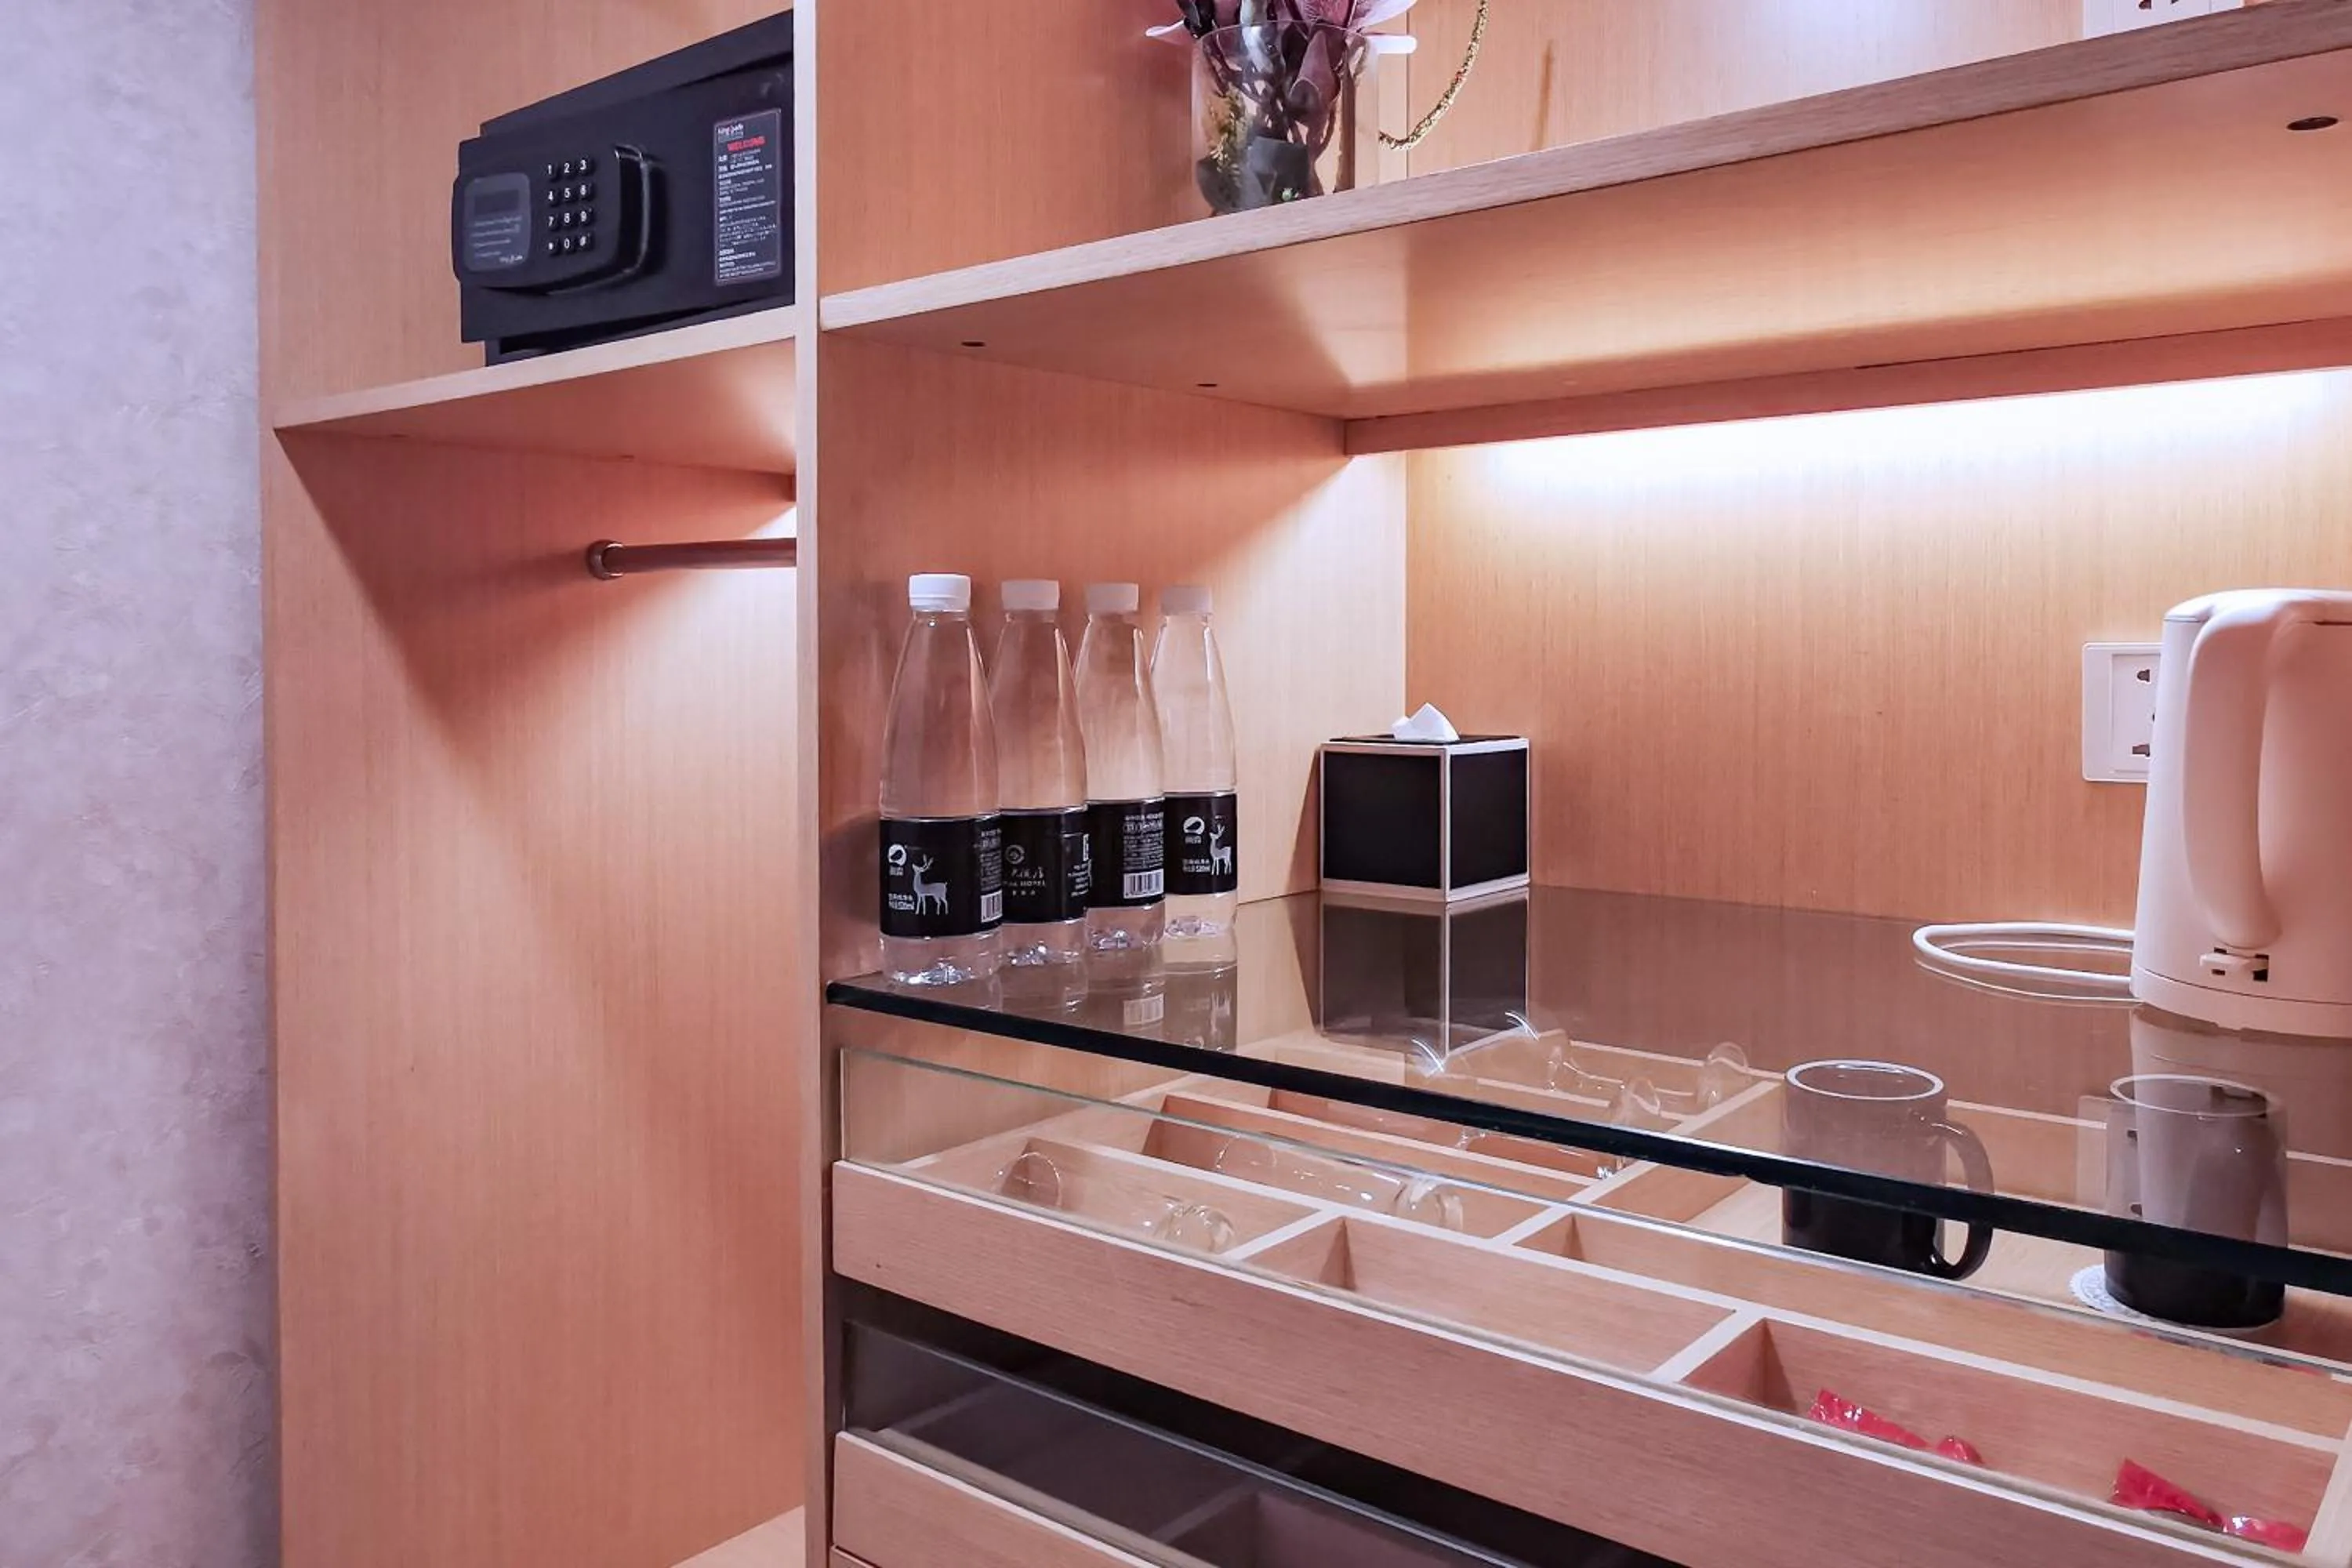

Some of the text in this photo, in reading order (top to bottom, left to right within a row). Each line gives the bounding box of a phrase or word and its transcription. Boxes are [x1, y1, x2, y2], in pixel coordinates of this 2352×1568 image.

[547, 159, 586, 174] 1 2 3
[548, 184, 586, 201] 4 5 6
[548, 211, 586, 226] 7 8 9
[564, 238, 570, 249] 0
